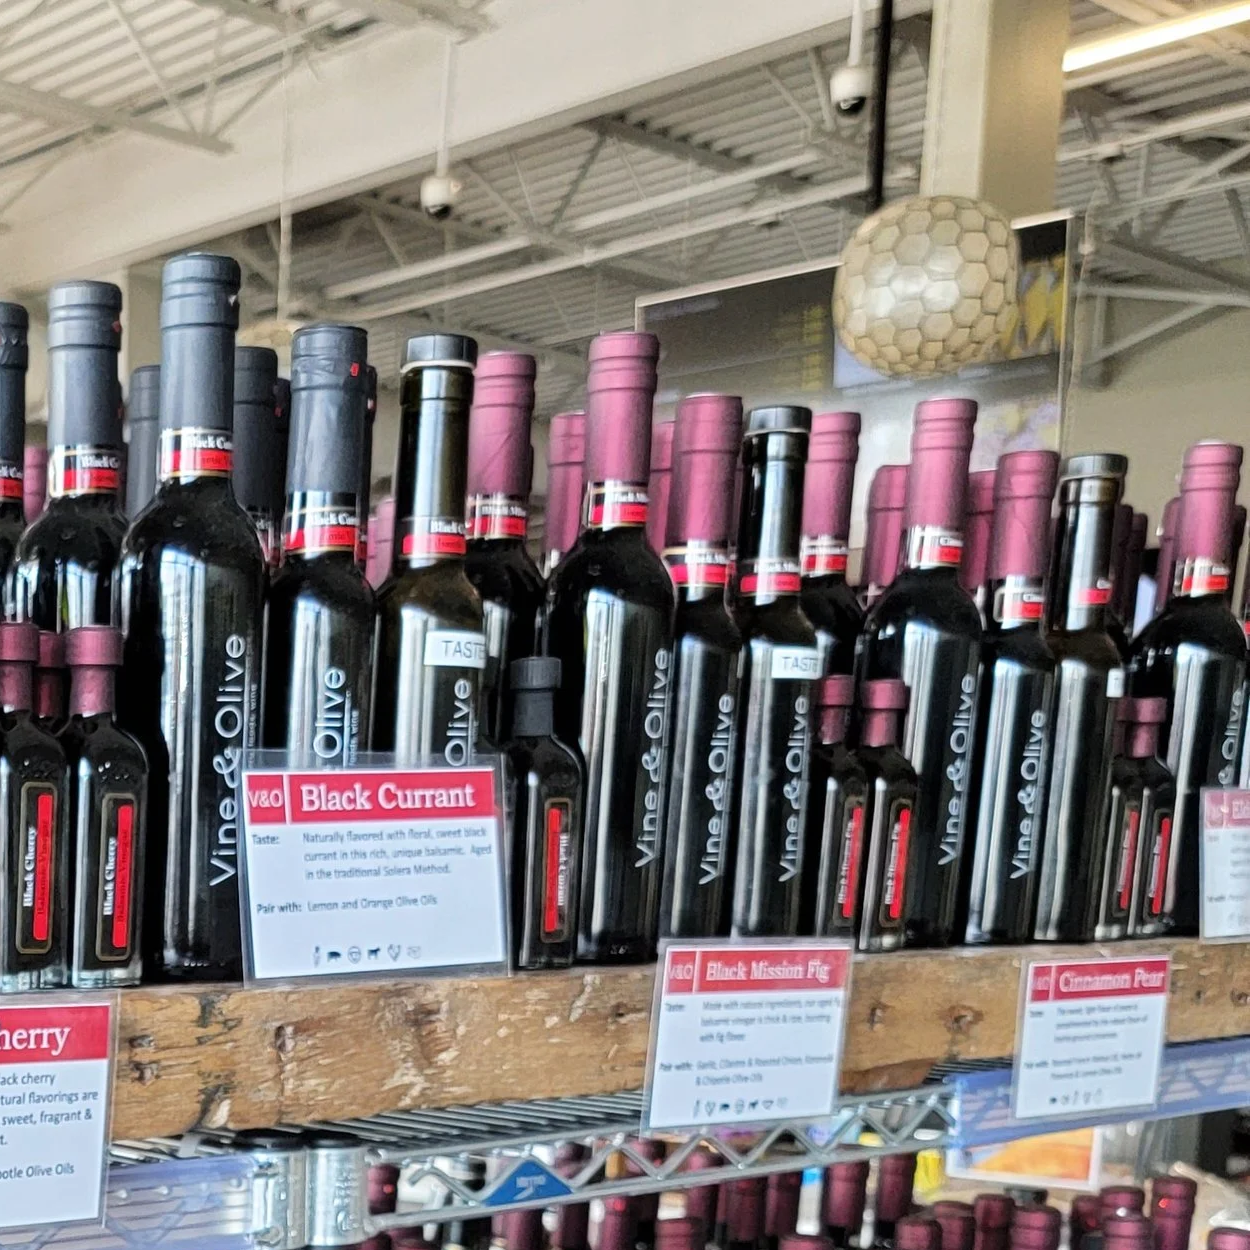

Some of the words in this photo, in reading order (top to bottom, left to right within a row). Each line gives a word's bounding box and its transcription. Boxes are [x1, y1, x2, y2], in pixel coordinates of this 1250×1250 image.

[247, 789, 283, 810] V&O
[300, 782, 372, 811] Black
[377, 782, 475, 809] Currant
[252, 834, 279, 844] Taste:
[315, 868, 332, 879] the
[333, 866, 381, 878] traditional
[383, 866, 411, 876] Solera
[413, 863, 450, 873] Method.
[256, 903, 275, 913] Pair
[279, 902, 301, 912] with:
[307, 901, 339, 912] Lemon
[341, 899, 358, 909] and
[360, 898, 393, 909] Orange
[395, 896, 418, 907] Olive
[420, 894, 437, 905] Oils
[20, 1072, 55, 1085] cherry
[28, 1091, 79, 1104] flavorings
[81, 1091, 98, 1101] are
[1, 1113, 37, 1126] sweet,
[39, 1110, 81, 1125] fragrant
[84, 1108, 92, 1120] &
[25, 1165, 52, 1178] Olive
[55, 1162, 75, 1175] Oils
